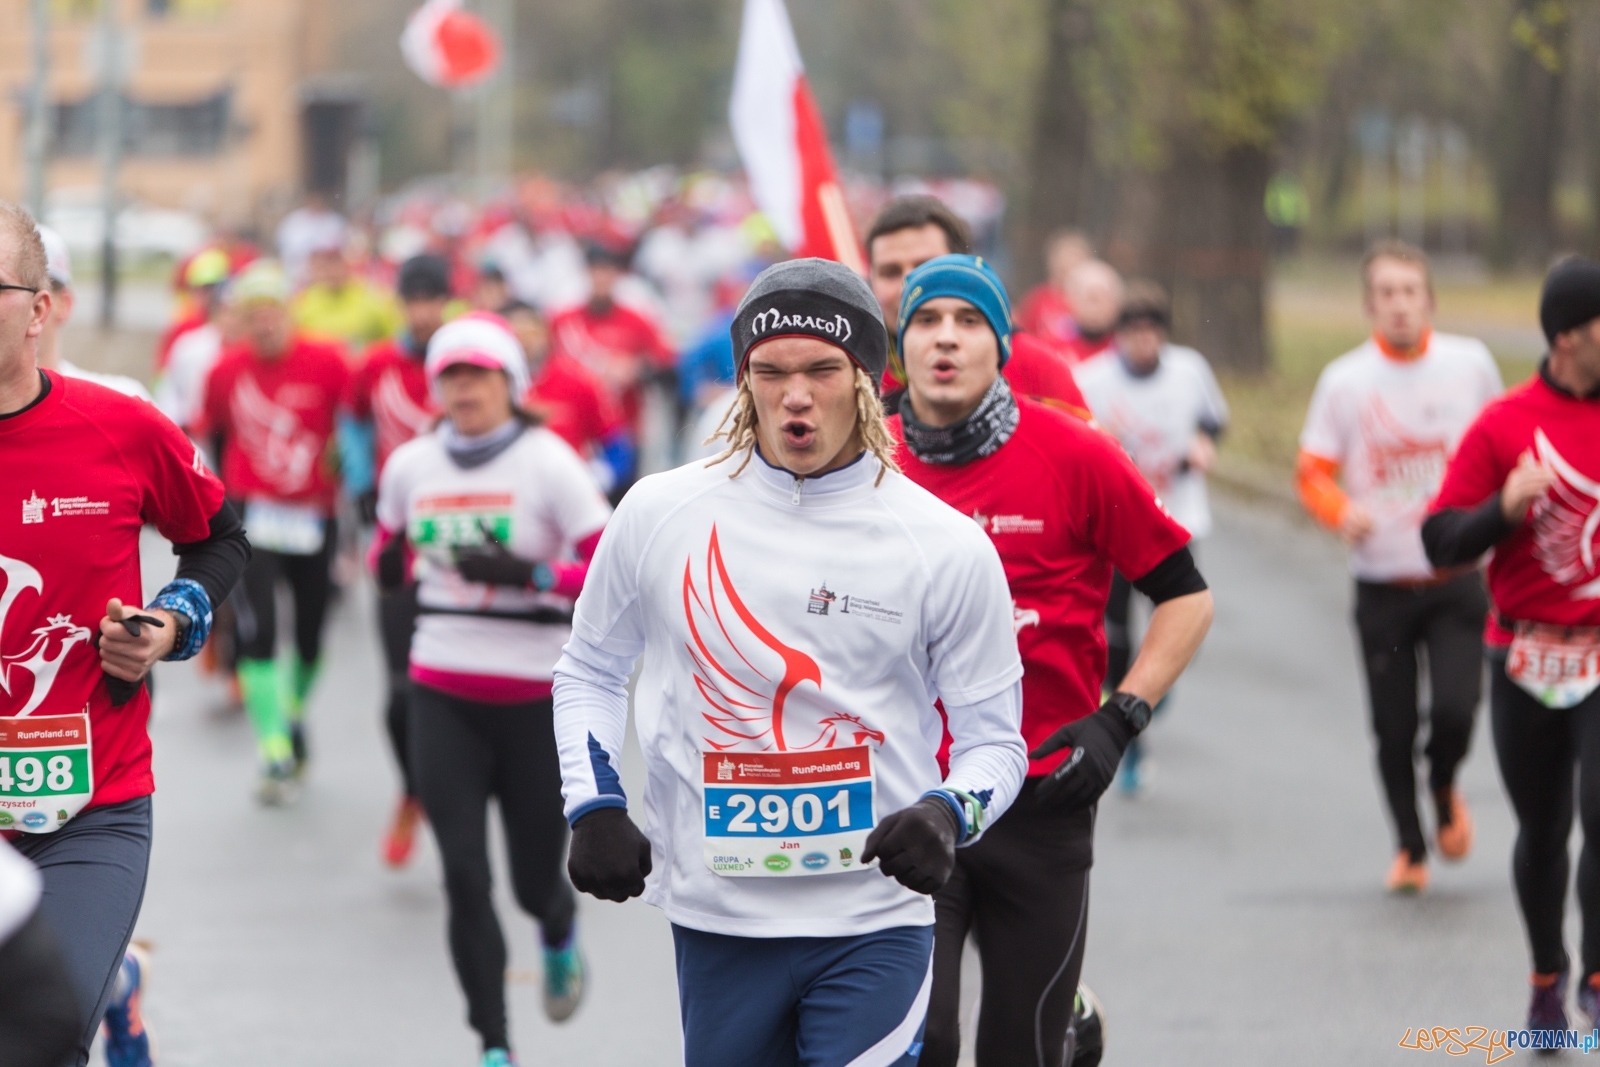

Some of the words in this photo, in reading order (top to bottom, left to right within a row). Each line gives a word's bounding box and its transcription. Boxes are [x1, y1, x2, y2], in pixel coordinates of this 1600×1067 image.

[51, 497, 62, 516] 1
[840, 595, 850, 614] 1
[17, 729, 79, 740] RunPoland.org
[0, 755, 74, 793] 498
[792, 761, 860, 775] RunPoland.org
[709, 806, 721, 820] E
[727, 789, 850, 834] 2901
[780, 841, 800, 849] Jan
